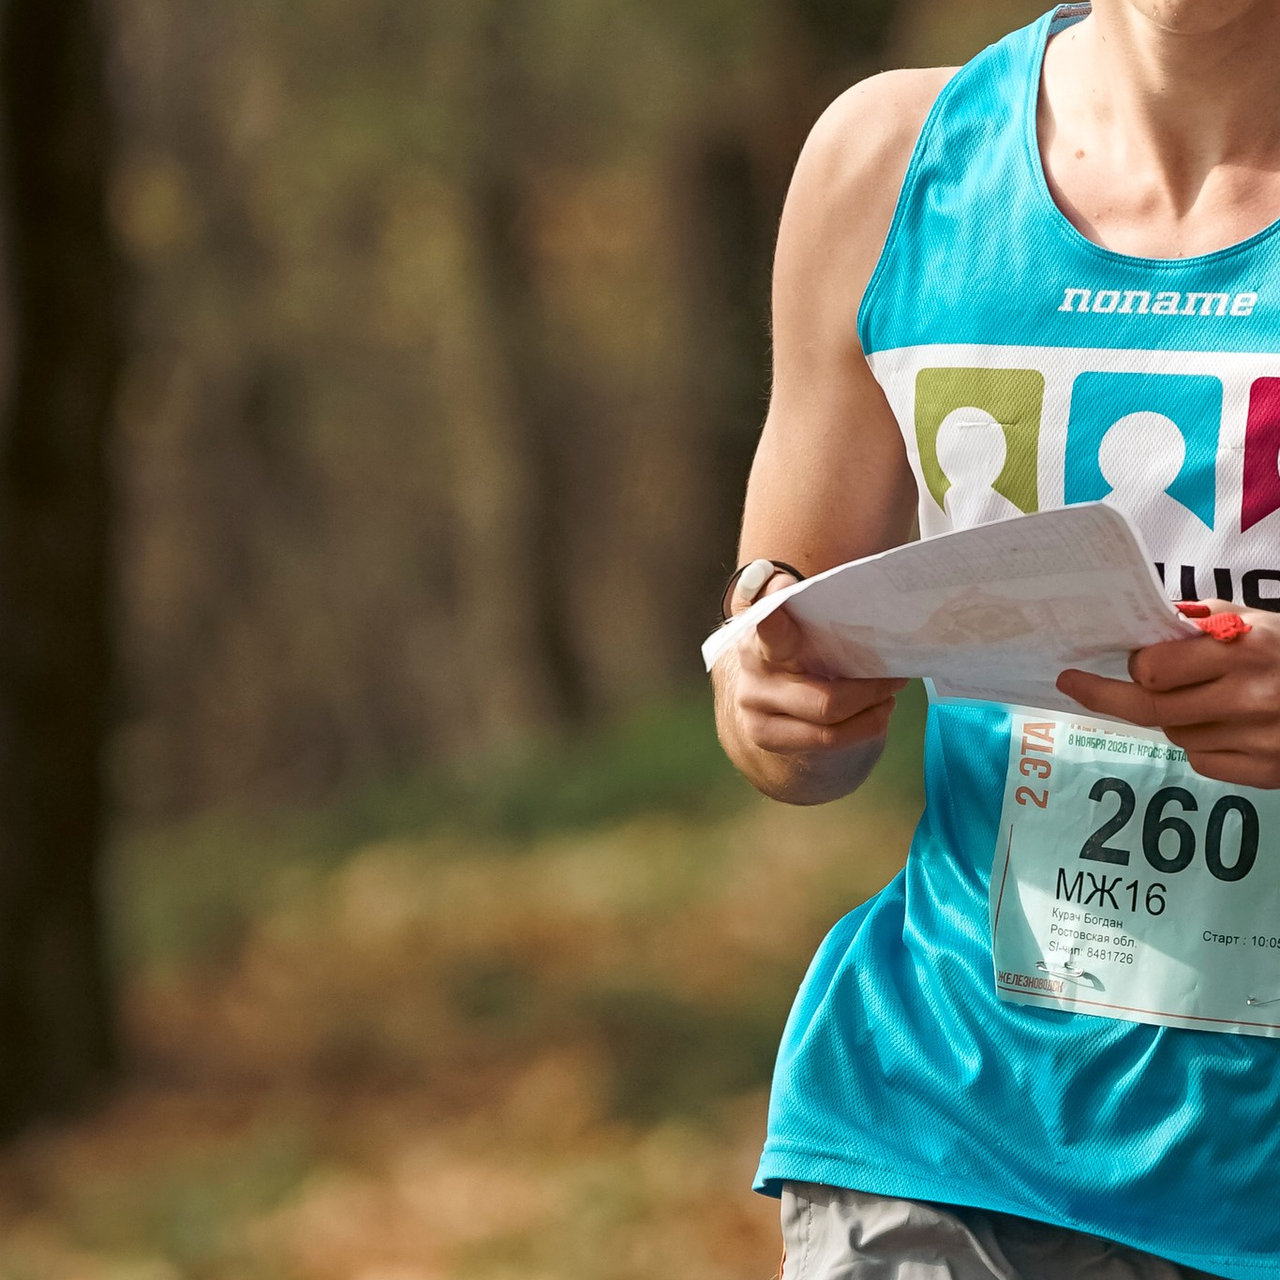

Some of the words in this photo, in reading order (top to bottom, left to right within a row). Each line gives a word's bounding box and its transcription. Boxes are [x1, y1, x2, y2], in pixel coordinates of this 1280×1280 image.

[1058, 287, 1258, 317] noname
[1068, 733, 1075, 746] 8
[1075, 735, 1106, 750] НОЯБРЯ
[1015, 786, 1049, 809] 2
[1079, 776, 1260, 883] 260
[1055, 867, 1167, 916] МЖ16
[1052, 907, 1081, 922] Курач
[1084, 912, 1123, 929] Богдан
[1050, 923, 1110, 944] Ростовская
[1113, 935, 1137, 949] обл.
[1202, 930, 1240, 946] Старт
[1086, 947, 1134, 965] 8481726
